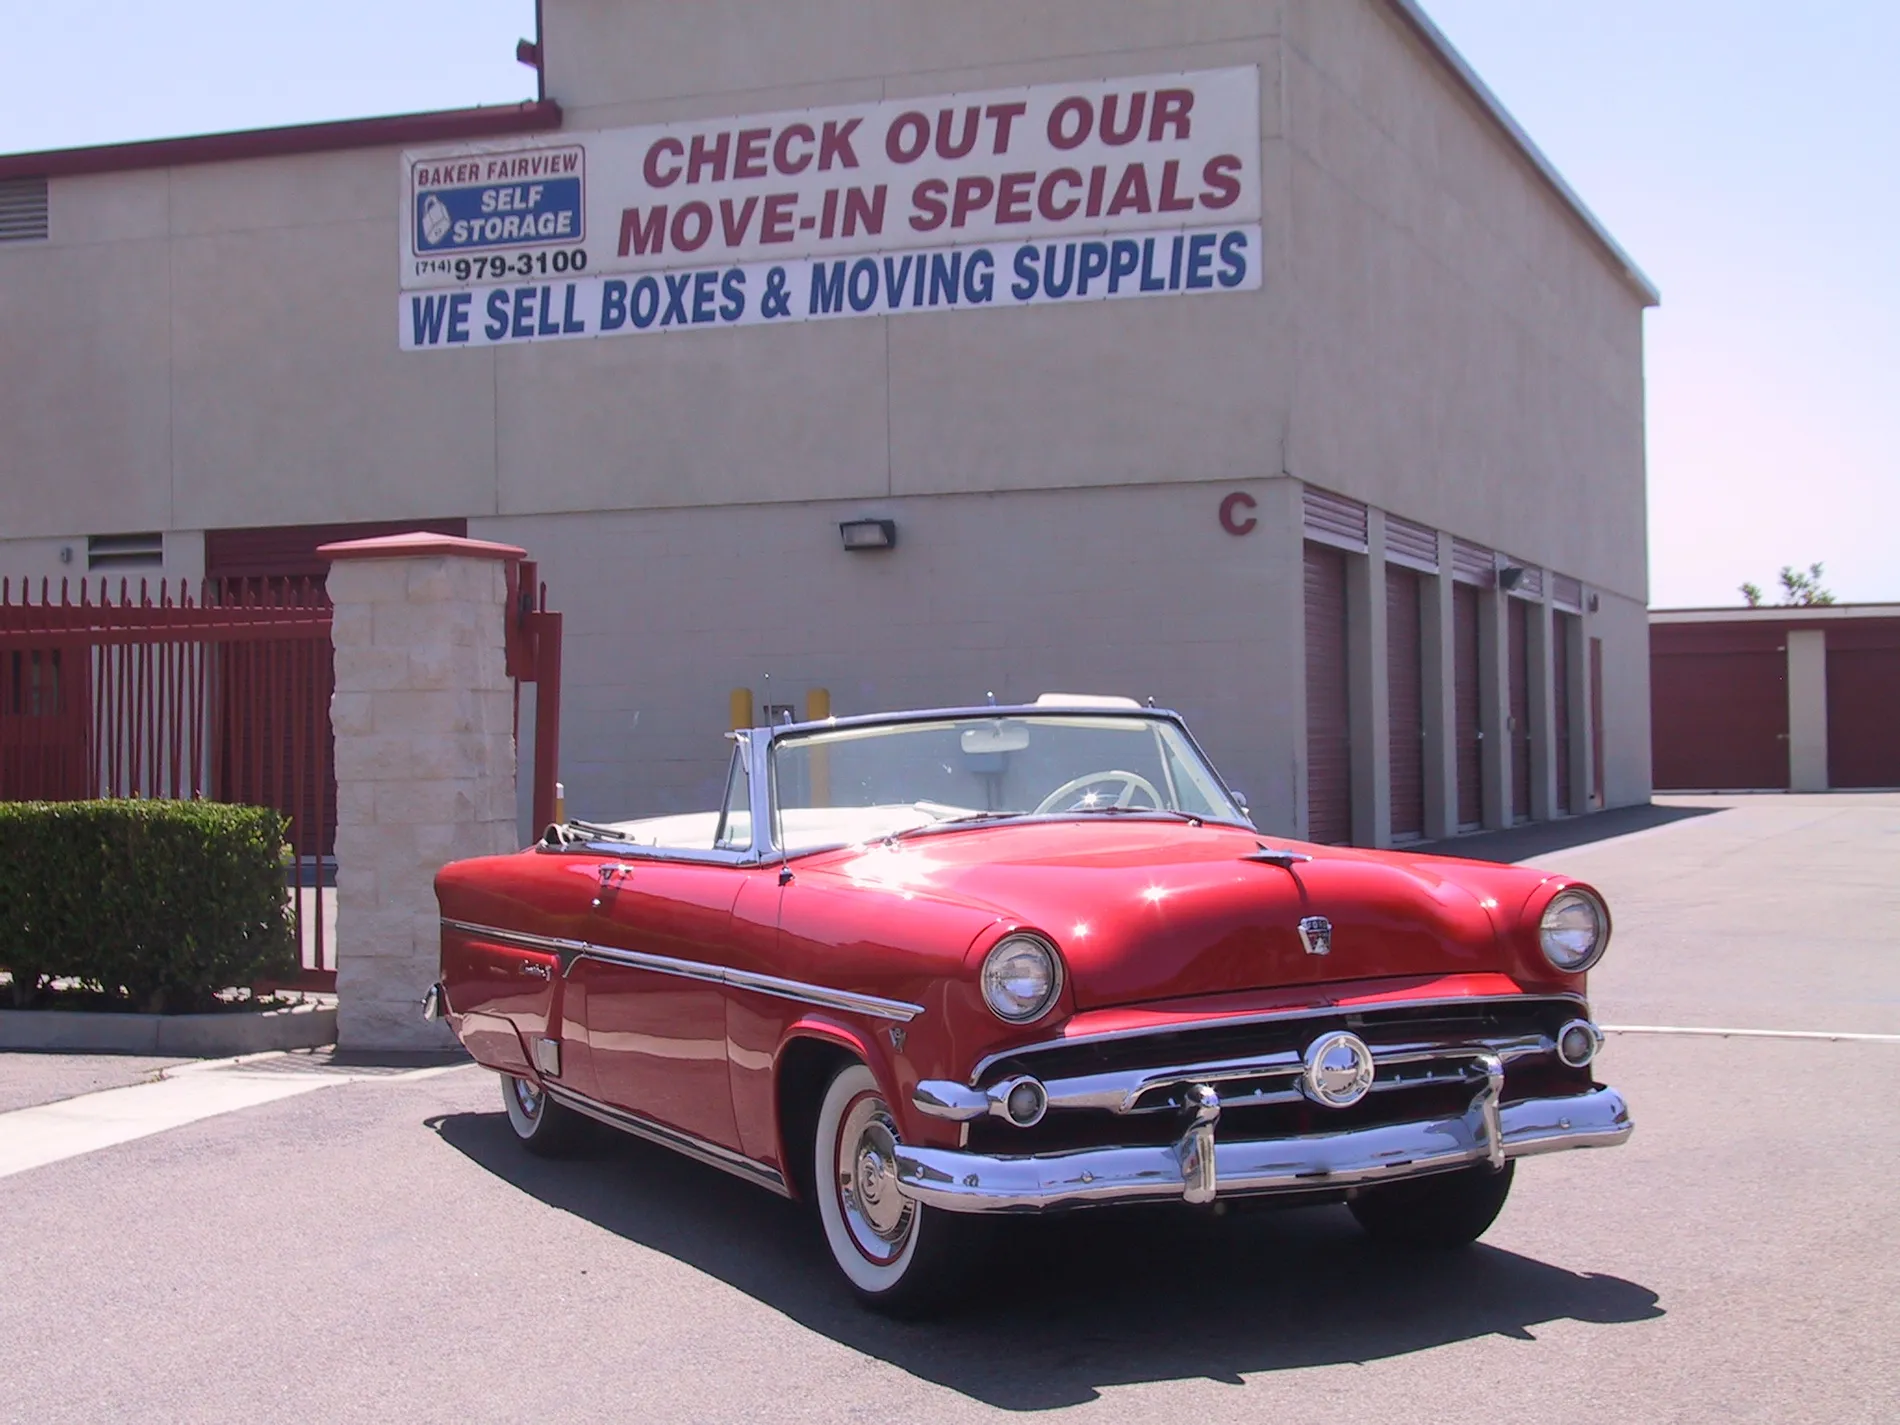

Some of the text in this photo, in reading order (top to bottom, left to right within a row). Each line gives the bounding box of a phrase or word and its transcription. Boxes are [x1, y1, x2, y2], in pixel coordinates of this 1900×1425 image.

[643, 88, 1195, 188] CHECK OUT OUR
[418, 153, 578, 186] BAKER FAIRVIEW
[480, 185, 544, 213] SELF
[617, 154, 1243, 258] MOVE-IN SPECIALS
[452, 210, 573, 243] STORAGE
[415, 249, 588, 281] (714) 979-3100
[412, 231, 1248, 346] WE SELL BOXES & MOVING SUPPLIES
[1218, 491, 1257, 536] C
